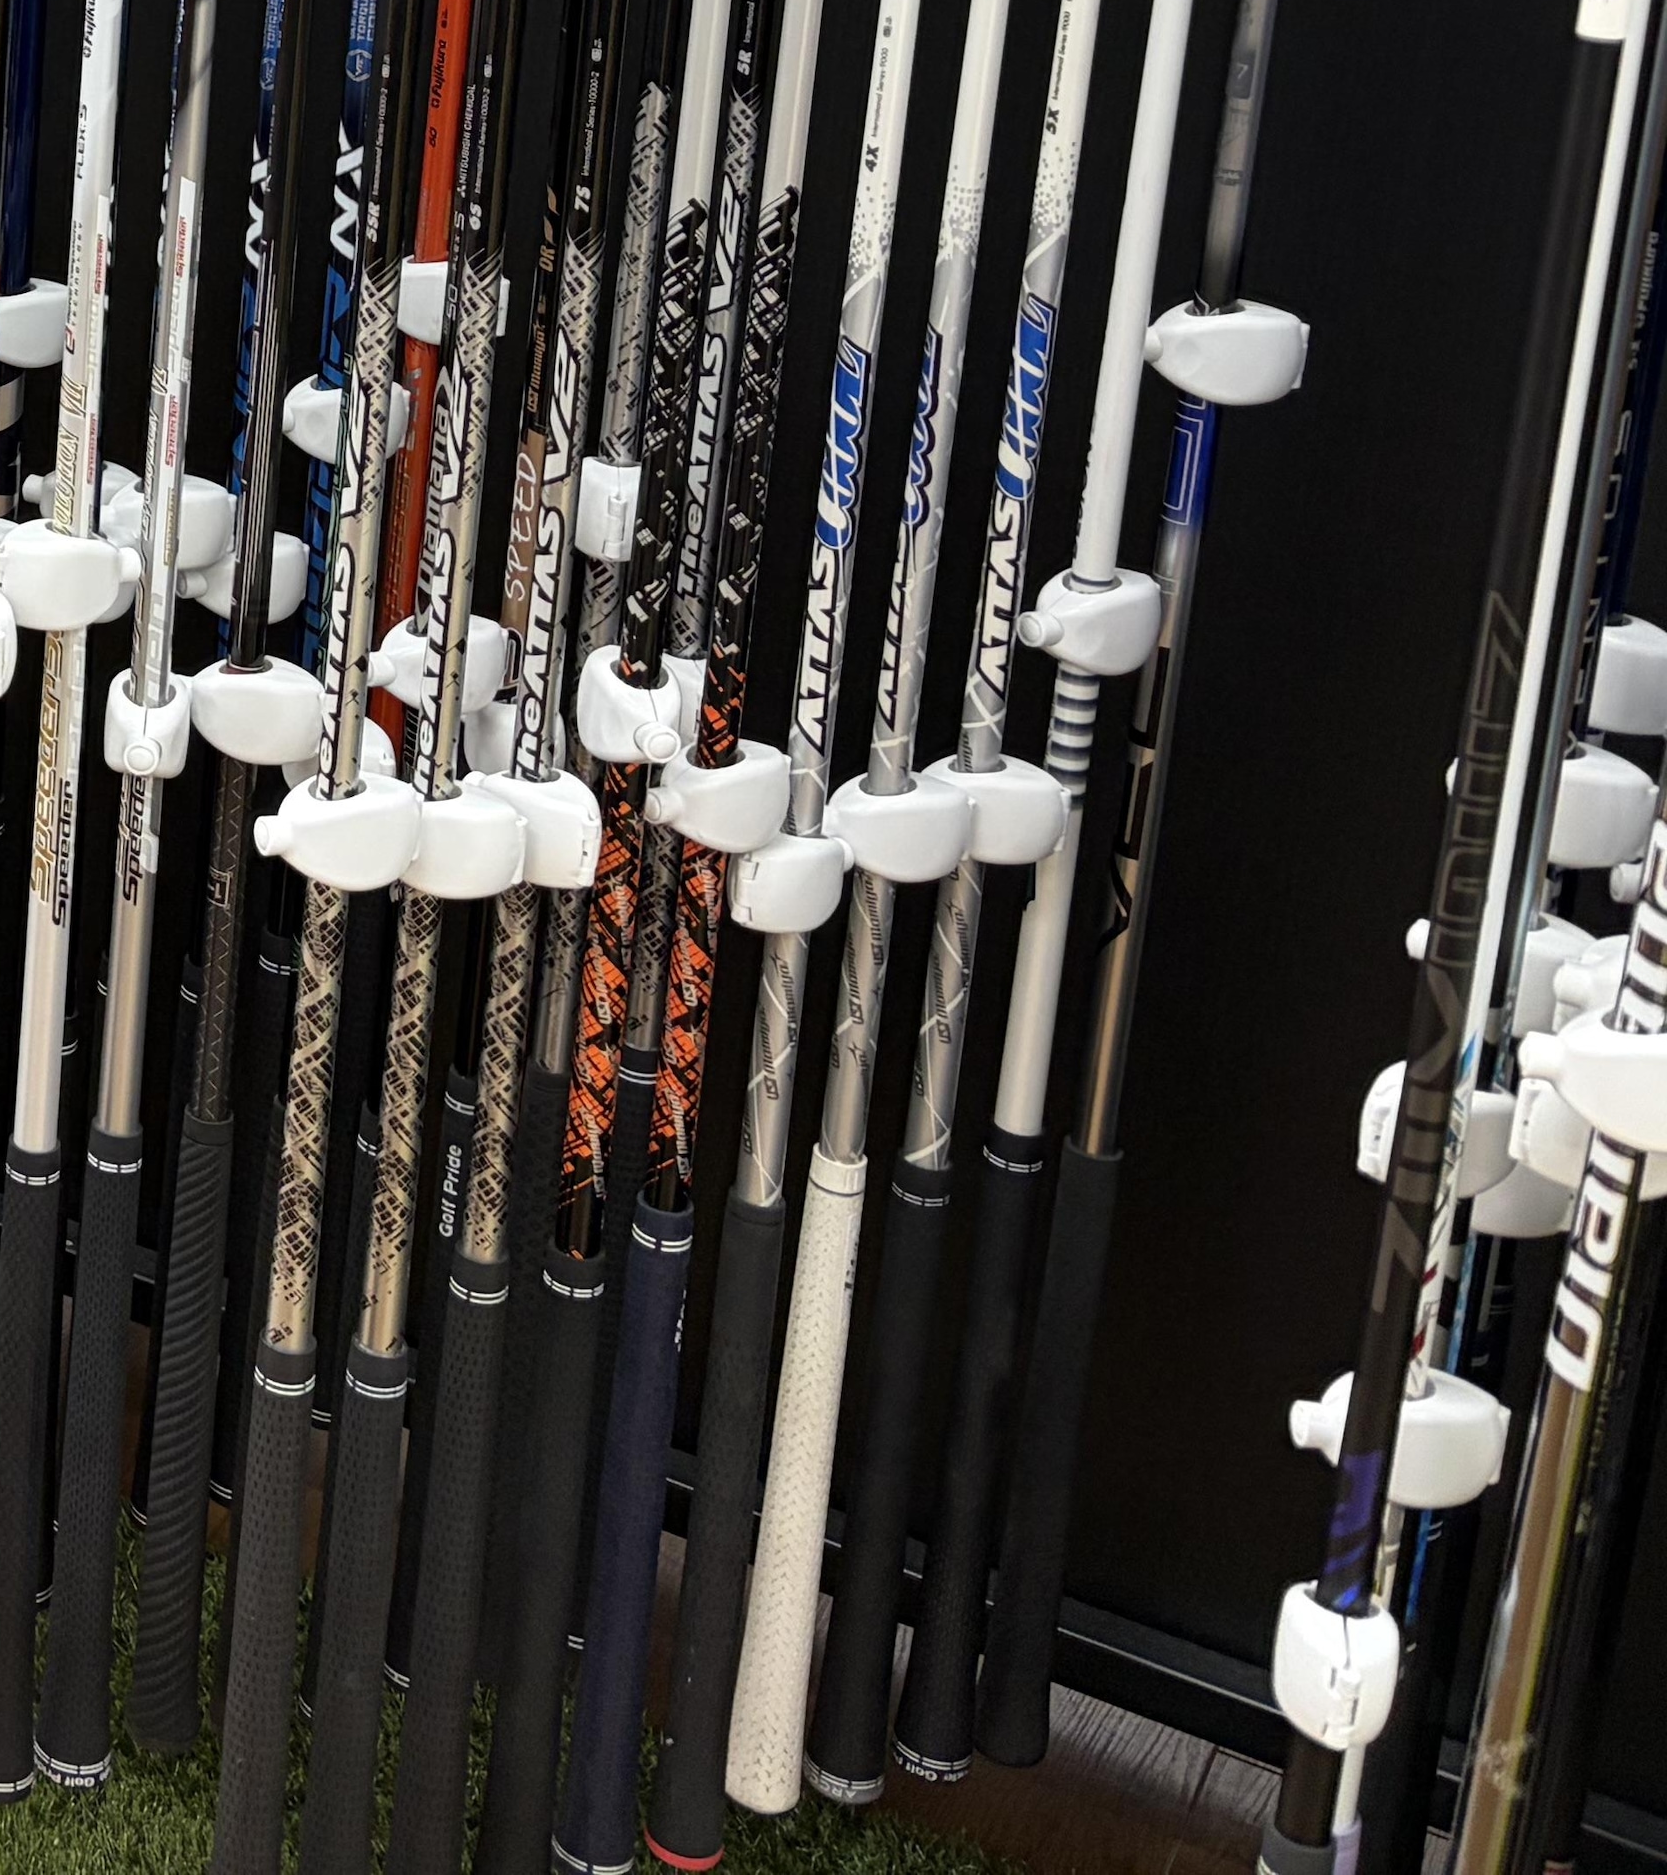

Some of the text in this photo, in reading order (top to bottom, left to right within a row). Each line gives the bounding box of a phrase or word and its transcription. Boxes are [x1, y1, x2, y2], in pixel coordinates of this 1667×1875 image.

[431, 40, 446, 96] Fujikura
[737, 50, 752, 75] 5R
[1045, 106, 1059, 135] 5X
[865, 144, 879, 172] 4X
[366, 202, 380, 242] 5SR
[469, 203, 482, 230] 6S
[575, 185, 590, 213] 7S
[708, 171, 746, 312] V2
[507, 452, 537, 601] SPEED
[970, 490, 1022, 700] ATTAS
[795, 537, 840, 754] ATTAS
[123, 776, 146, 906] Speede
[438, 1143, 462, 1238] Golf Pride
